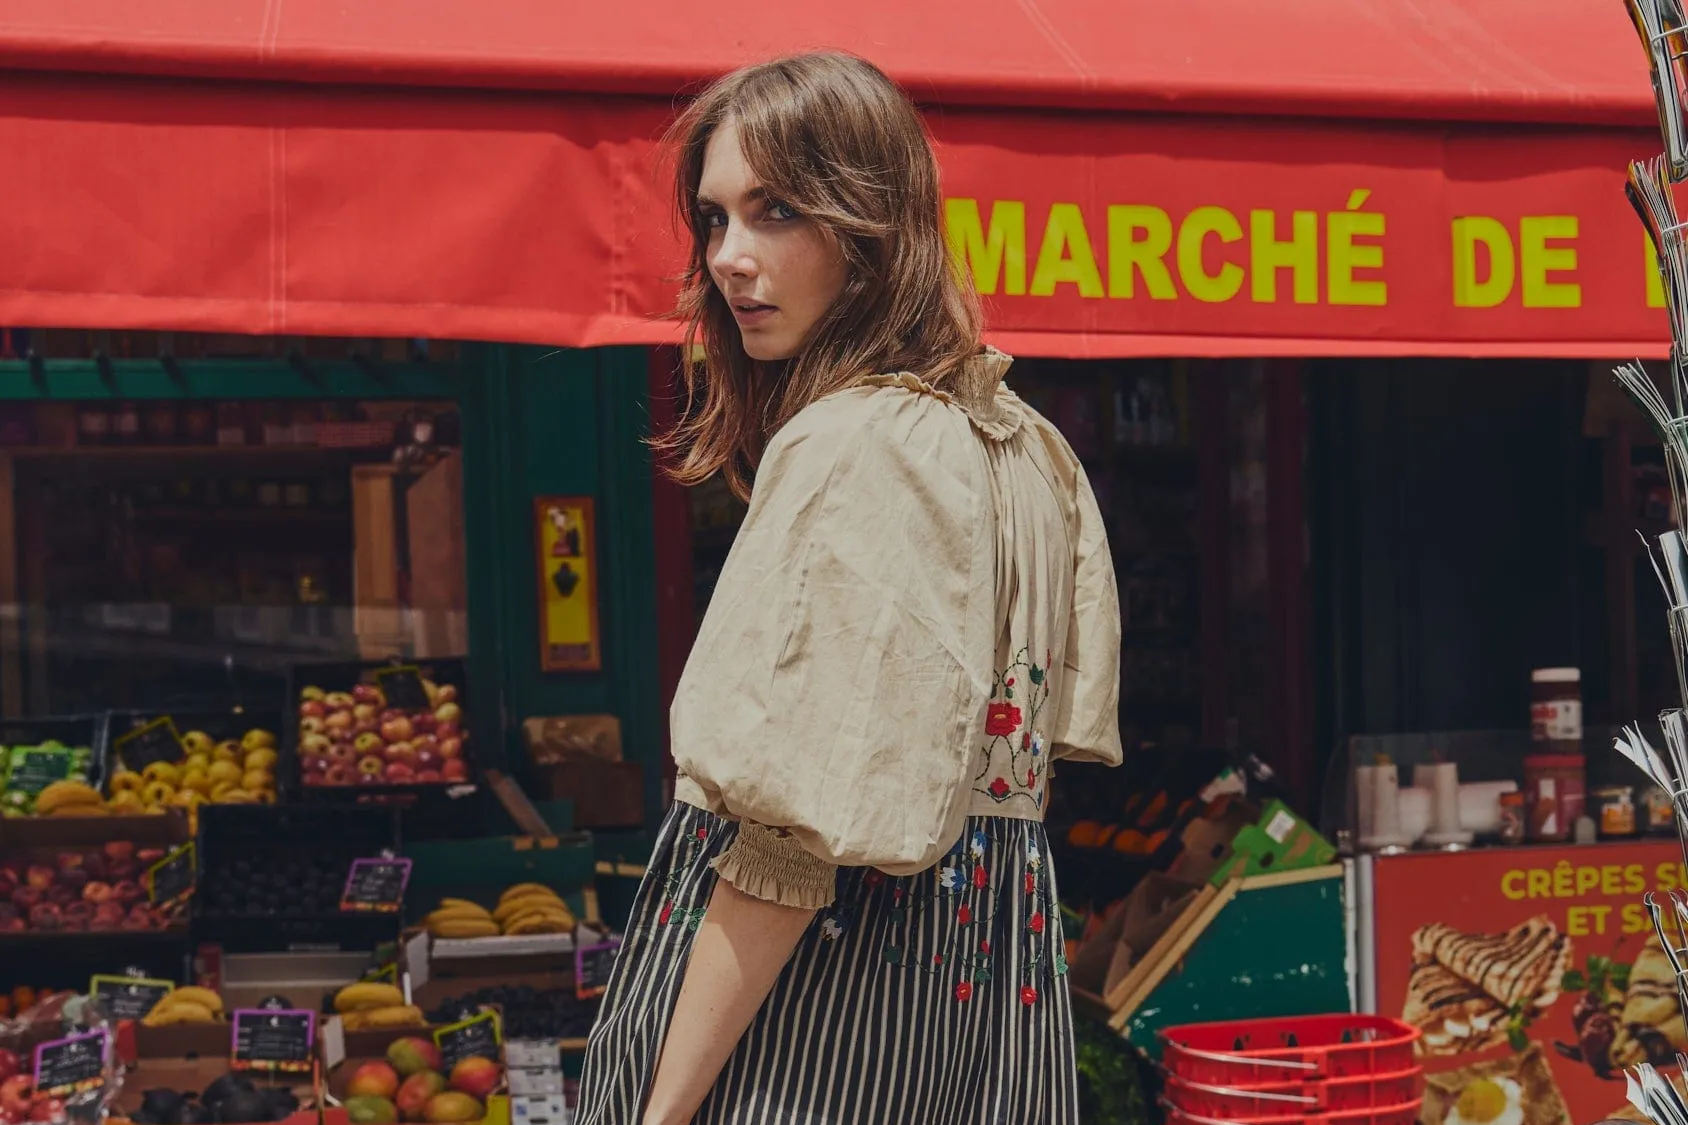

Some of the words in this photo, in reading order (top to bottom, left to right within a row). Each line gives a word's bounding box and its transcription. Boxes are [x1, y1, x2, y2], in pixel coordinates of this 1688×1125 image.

[944, 189, 1388, 304] MARCHÉ
[1452, 215, 1582, 308] DE
[1501, 860, 1646, 899] CRÊPES
[1568, 905, 1612, 936] ET
